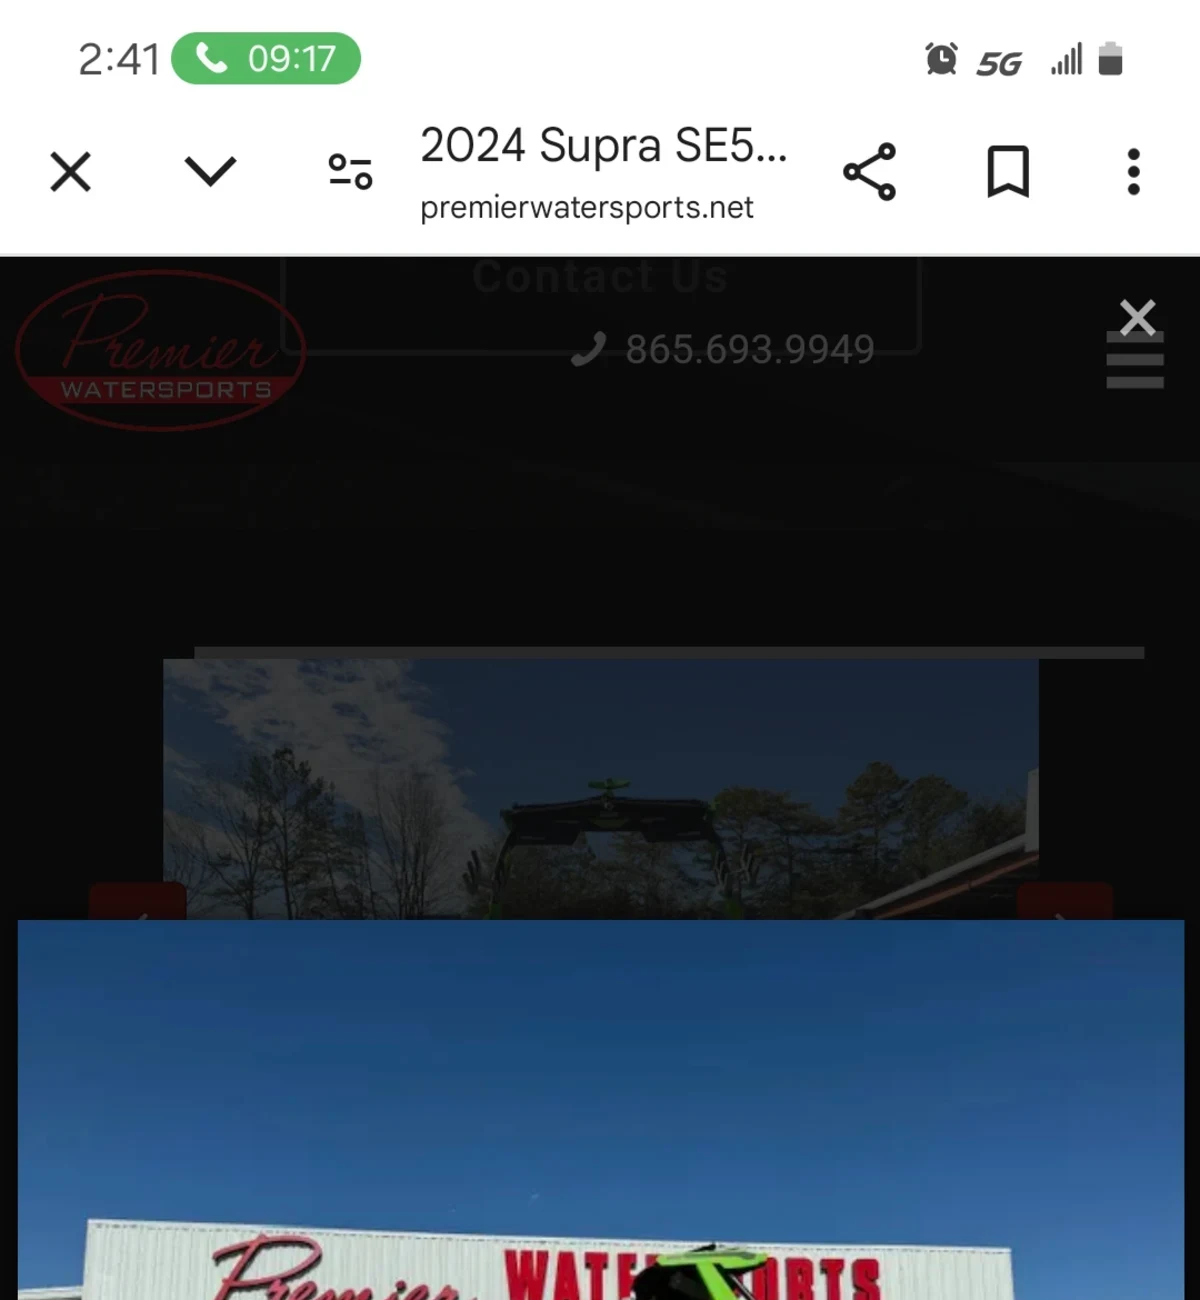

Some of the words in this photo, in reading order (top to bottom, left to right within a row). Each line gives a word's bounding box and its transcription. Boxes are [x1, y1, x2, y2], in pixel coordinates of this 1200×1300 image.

[79, 42, 159, 76] 2:41
[248, 44, 337, 73] 09:17
[976, 51, 1022, 77] 5G
[421, 126, 526, 163] 2024
[540, 126, 661, 172] Supra
[421, 193, 754, 226] premierwatersports.net
[472, 258, 653, 293] Contact
[671, 258, 728, 293] Us
[61, 292, 280, 369] Premier
[626, 333, 875, 364] 865.693.9949
[60, 381, 271, 399] WATERSPORTS
